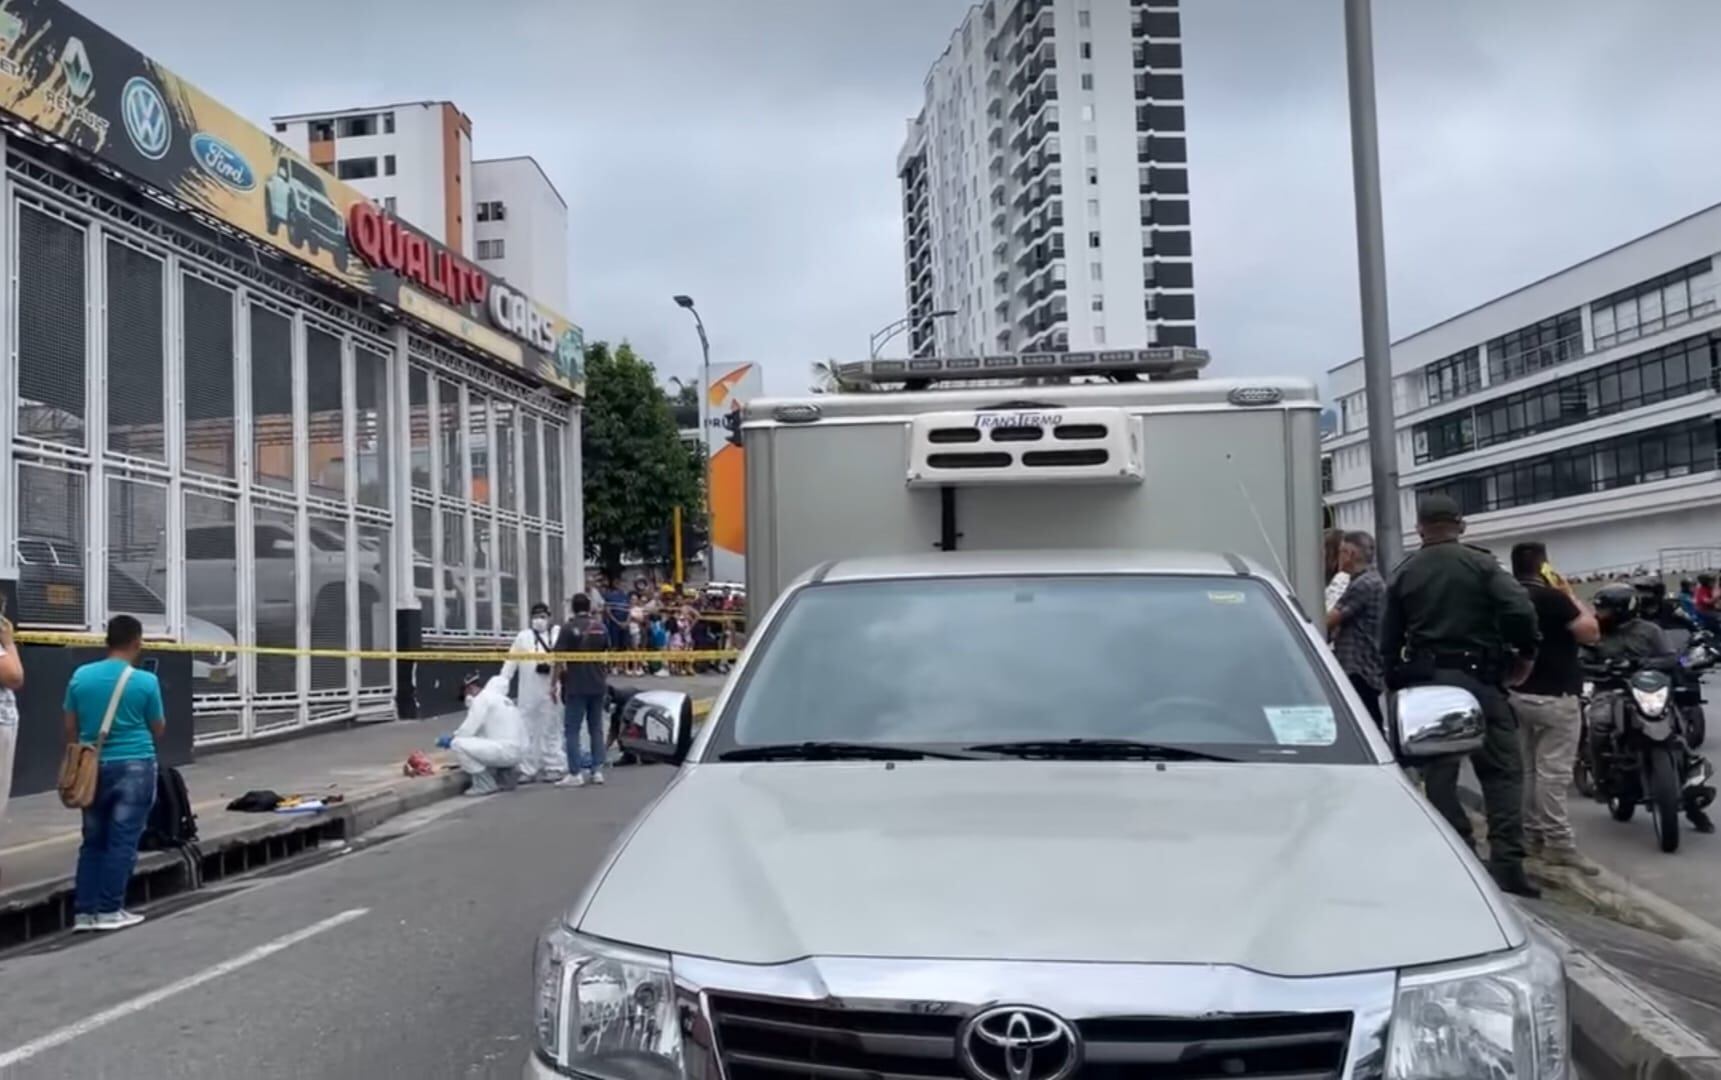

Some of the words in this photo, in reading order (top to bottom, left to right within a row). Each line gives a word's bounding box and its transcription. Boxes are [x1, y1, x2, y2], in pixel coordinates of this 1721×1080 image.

[204, 142, 246, 184] Ford
[348, 201, 488, 306] QUALITY
[490, 284, 556, 353] CARS
